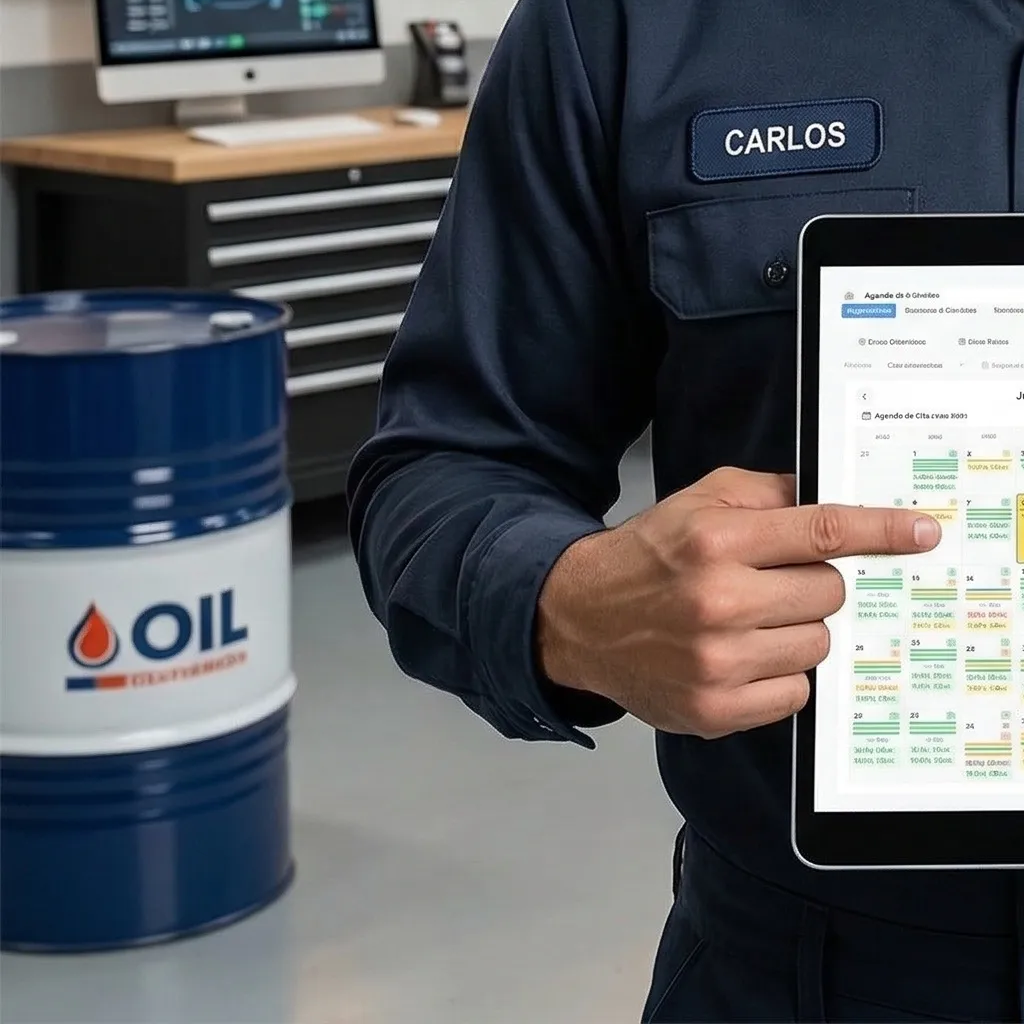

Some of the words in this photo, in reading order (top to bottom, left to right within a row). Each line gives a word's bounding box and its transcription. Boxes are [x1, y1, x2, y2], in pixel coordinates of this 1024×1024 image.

[725, 121, 846, 156] CARLOS
[904, 411, 915, 420] de
[131, 589, 248, 660] OIL
